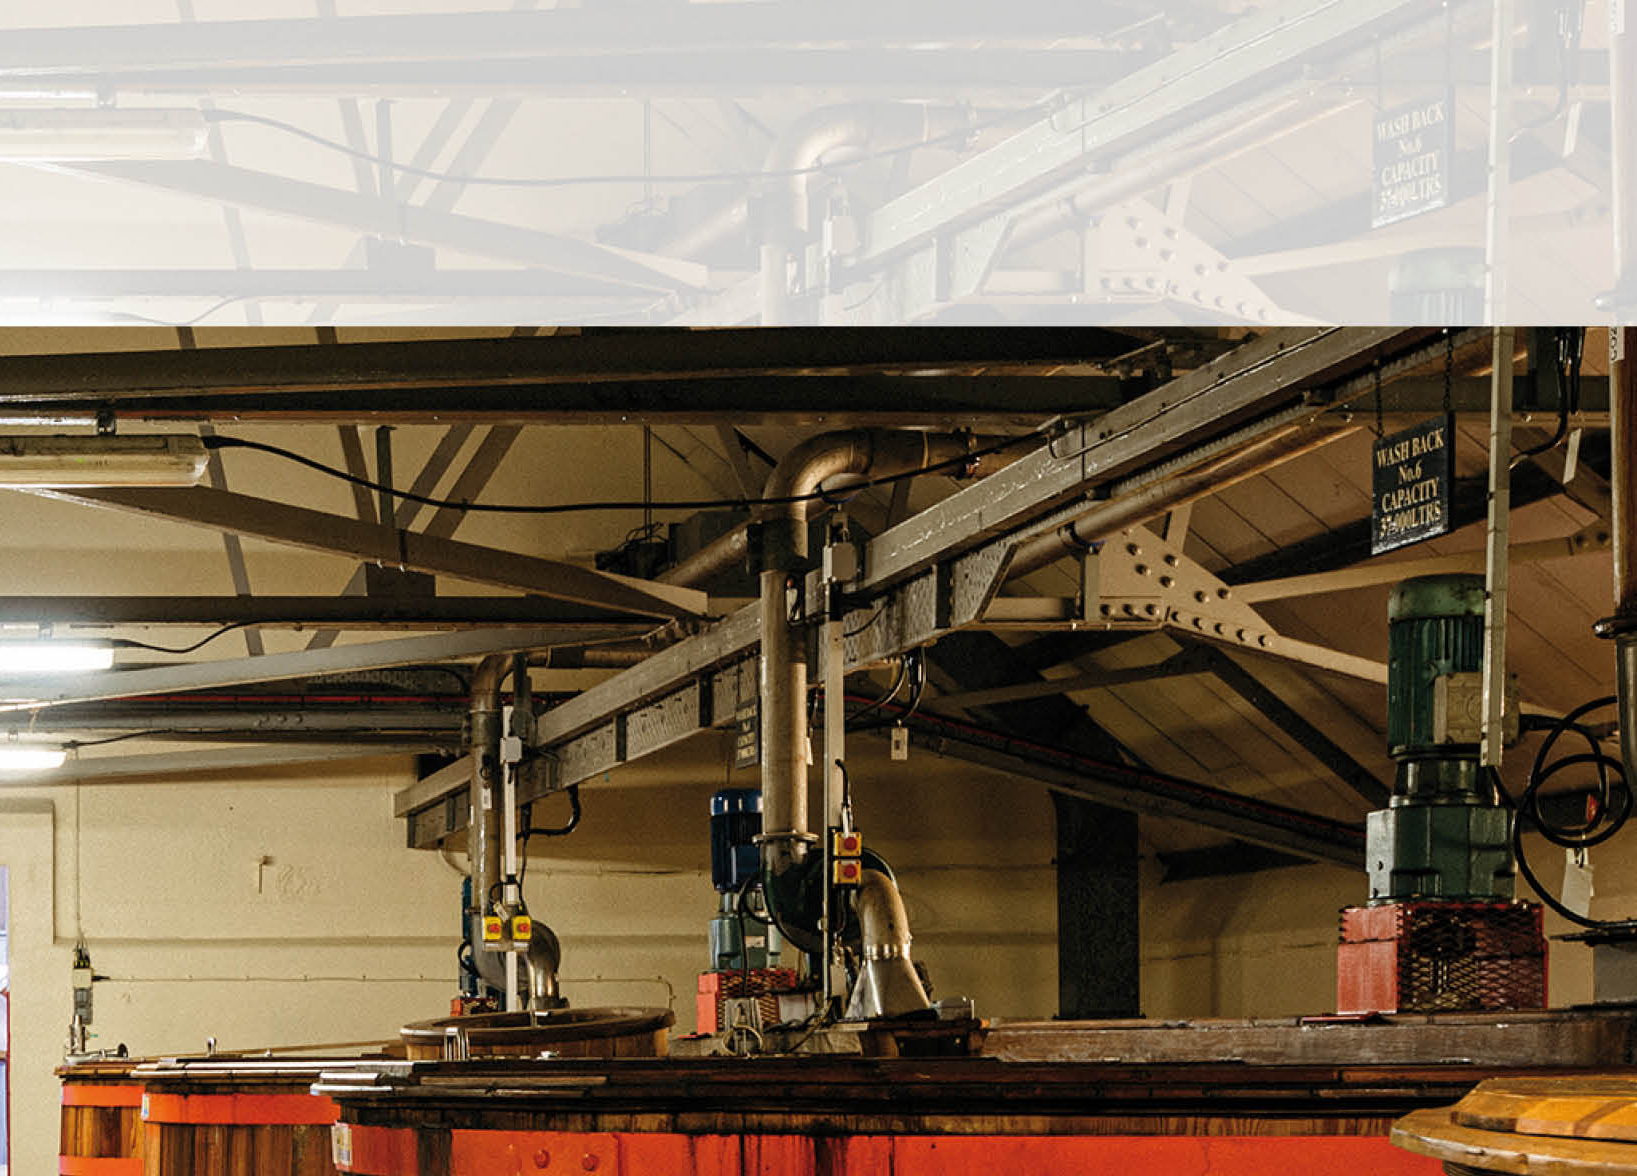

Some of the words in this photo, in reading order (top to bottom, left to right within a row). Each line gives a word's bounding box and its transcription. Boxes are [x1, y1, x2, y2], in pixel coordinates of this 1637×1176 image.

[1382, 150, 1440, 188] CAPACITY
[1377, 440, 1409, 469] WASH
[1412, 427, 1444, 458] BACK
[1382, 476, 1440, 514] CAPACITY
